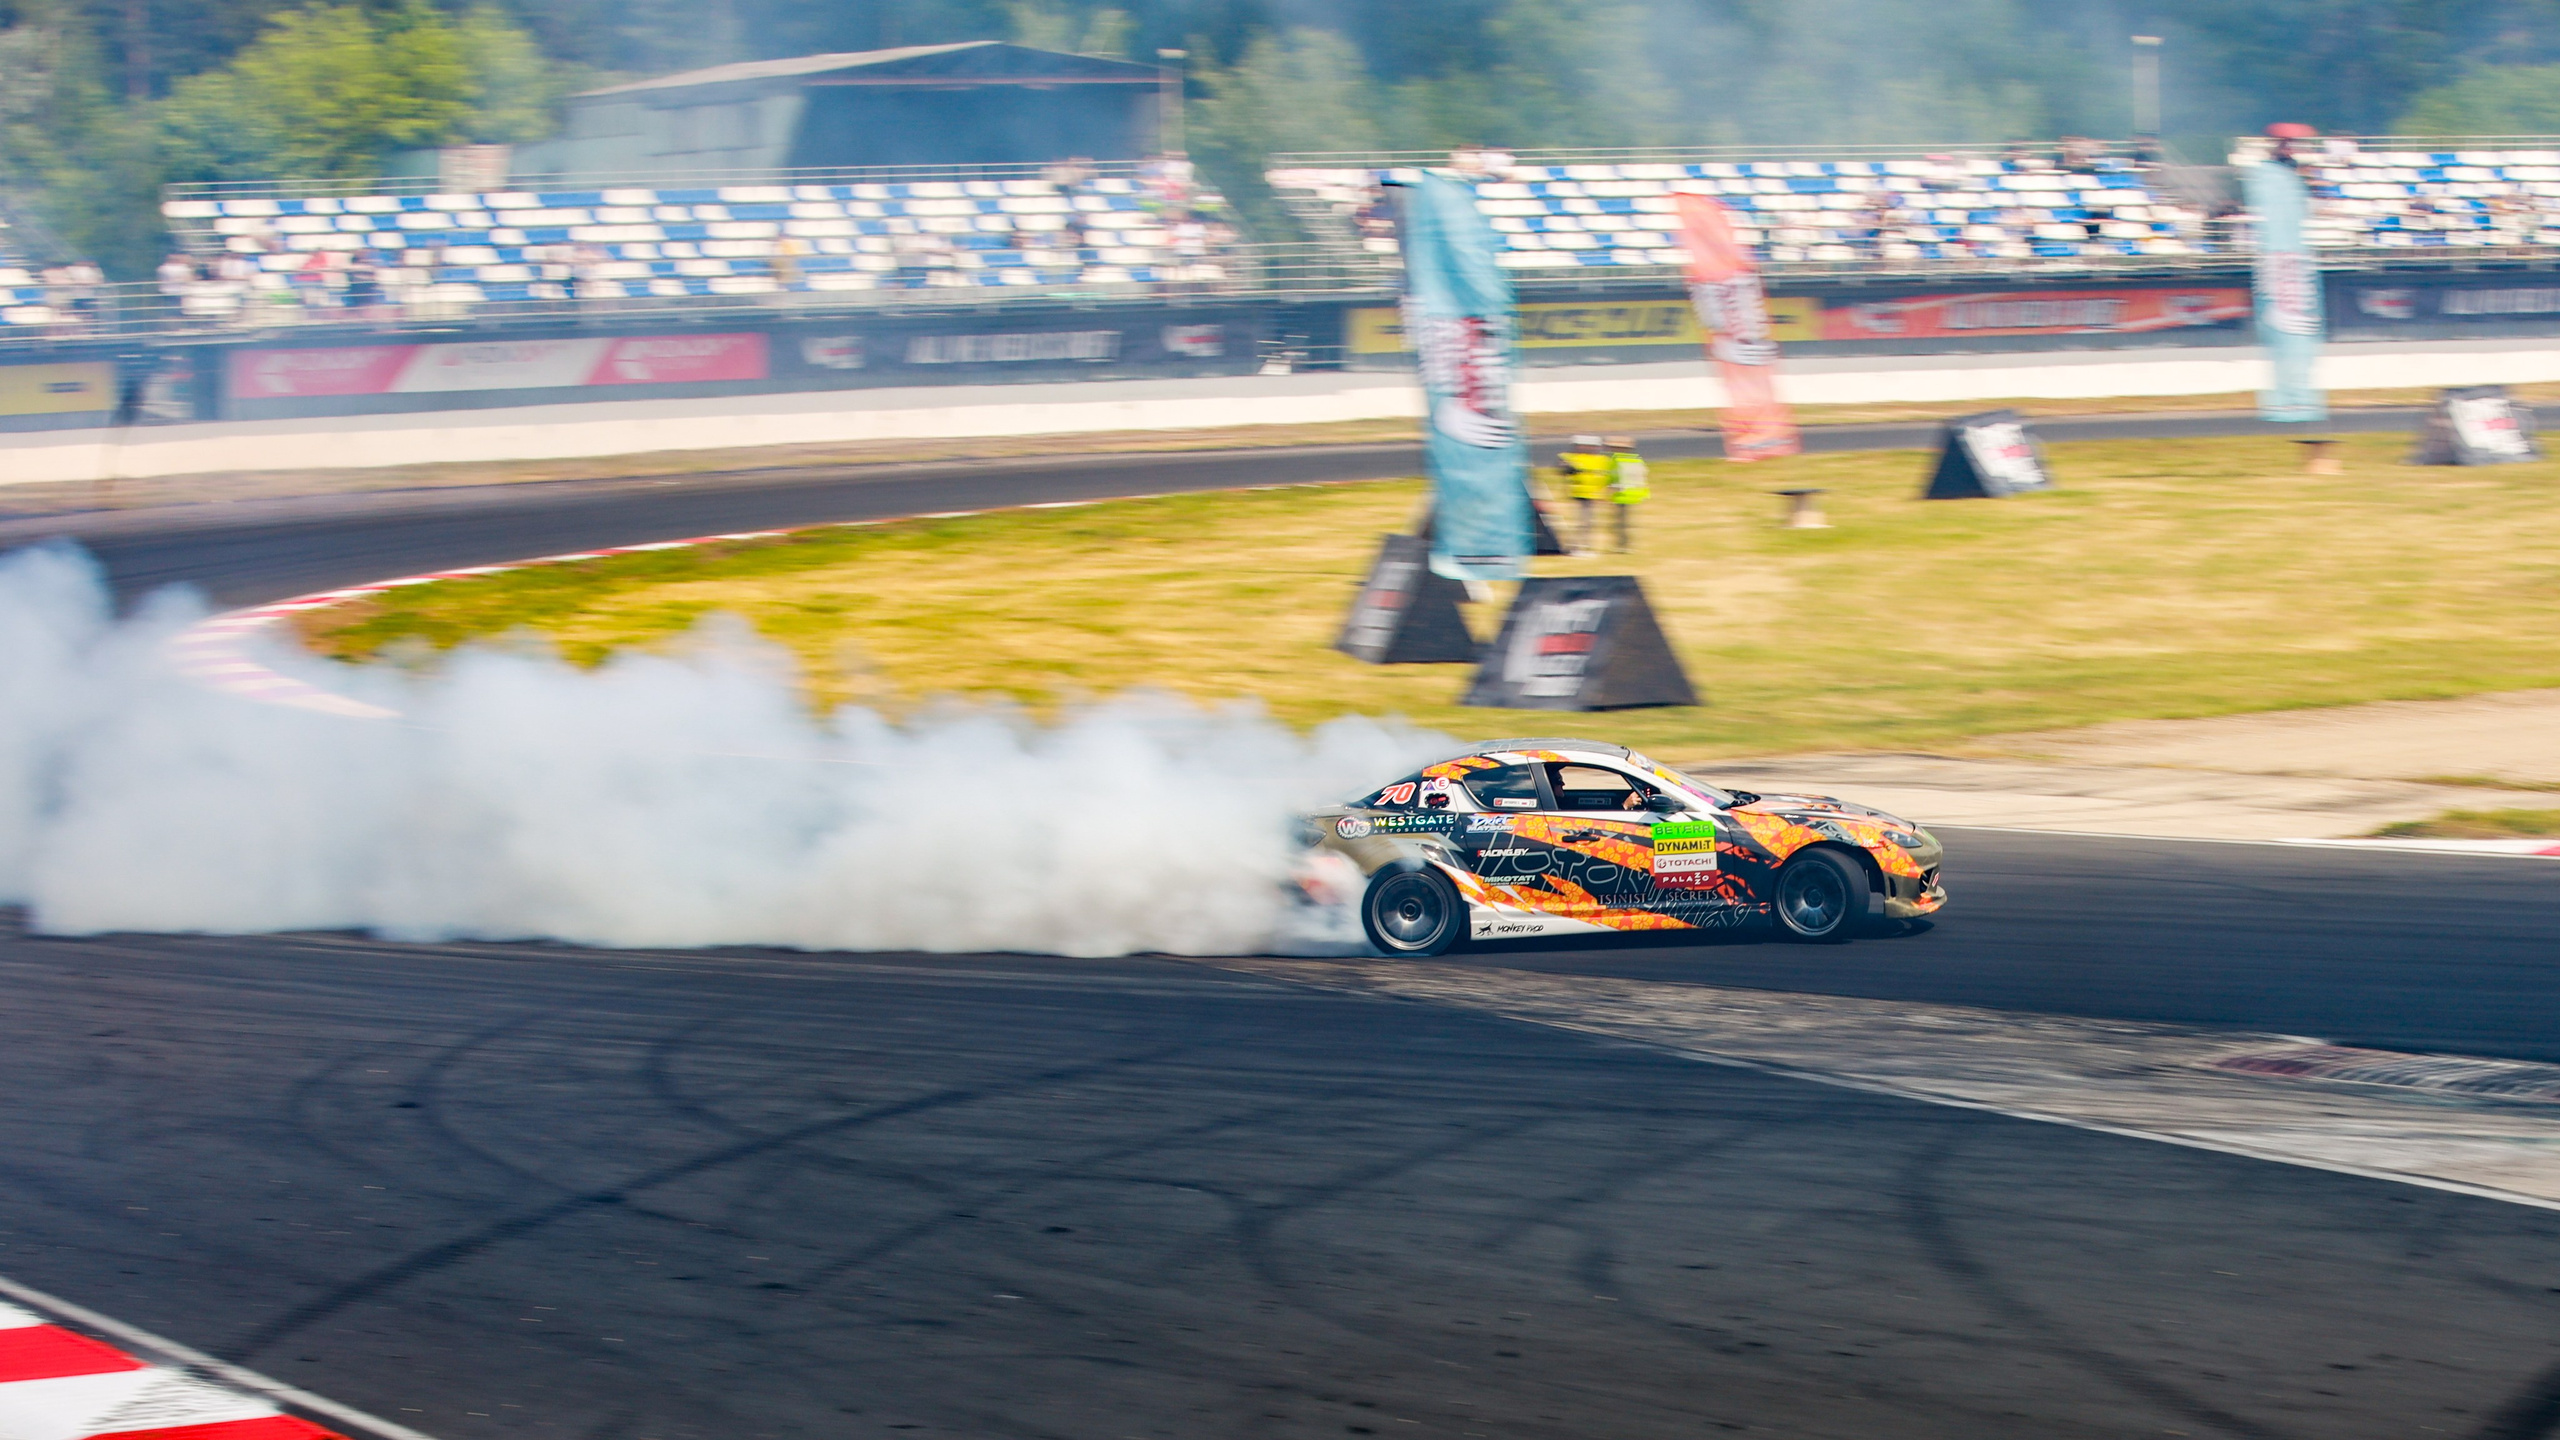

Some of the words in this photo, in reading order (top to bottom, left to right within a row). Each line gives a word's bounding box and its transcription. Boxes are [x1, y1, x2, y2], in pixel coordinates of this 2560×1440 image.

[1438, 779, 1446, 788] E
[1374, 781, 1417, 806] 70
[1373, 814, 1455, 827] WESTGATE
[1340, 820, 1369, 836] WG
[1373, 826, 1455, 834] AUTOSERVICE
[1466, 824, 1515, 833] MATSURI
[1655, 824, 1711, 836] BETERA
[1477, 847, 1530, 858] RACING.BY
[1667, 858, 1712, 867] TOTACHI
[1484, 874, 1536, 883] MIKOTATI
[1662, 872, 1710, 885] PALAZZO
[1667, 889, 1719, 902] SECRETS
[1497, 922, 1526, 933] MONKEY
